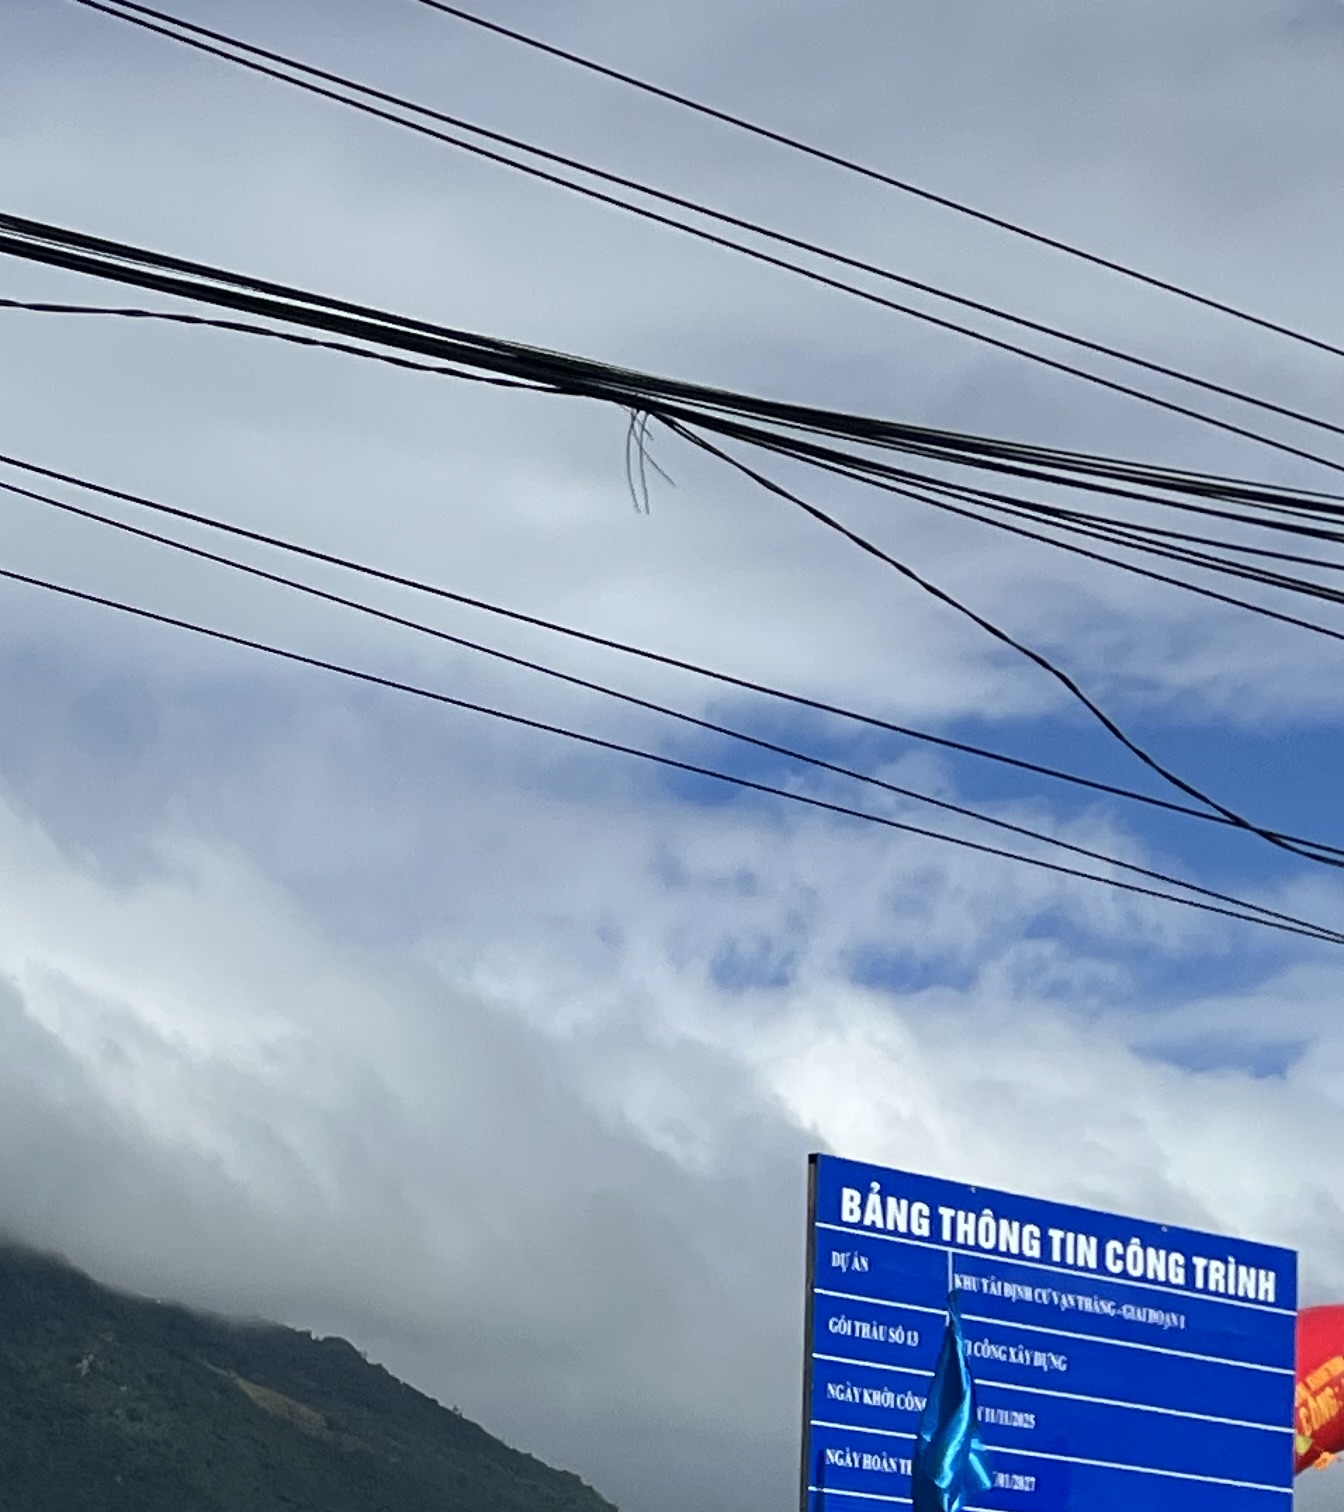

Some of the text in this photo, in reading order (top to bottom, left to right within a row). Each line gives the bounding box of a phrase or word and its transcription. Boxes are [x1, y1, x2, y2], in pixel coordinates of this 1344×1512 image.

[841, 1181, 1276, 1303] BẢNG THÔNG TIN CÔNG TRÌNH
[831, 1249, 870, 1274] DỰ ÁN
[954, 1273, 980, 1292] KHU
[828, 1315, 852, 1337] GÓI
[974, 1337, 1008, 1361] CÔNG
[827, 1382, 860, 1404] NGÀY
[825, 1447, 860, 1469] NGÀY
